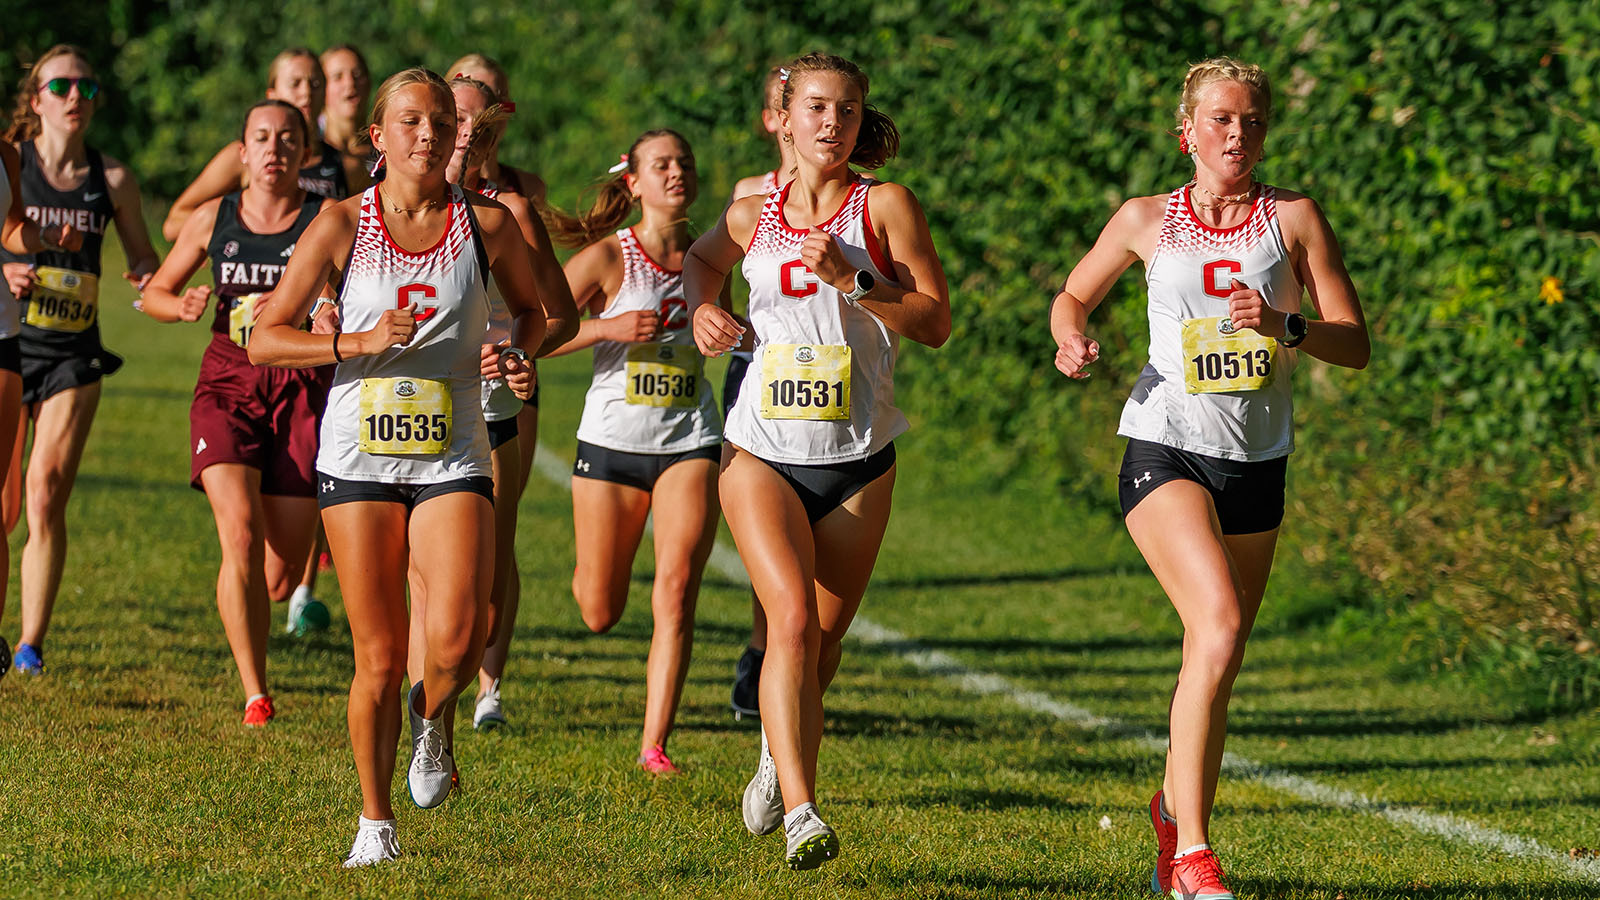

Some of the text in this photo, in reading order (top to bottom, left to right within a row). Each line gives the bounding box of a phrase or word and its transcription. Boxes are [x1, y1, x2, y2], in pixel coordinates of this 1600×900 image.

[25, 205, 106, 235] RINNELL
[220, 261, 288, 286] FAIT
[778, 257, 820, 299] C
[1201, 257, 1244, 300] C
[37, 296, 94, 323] 10634
[395, 281, 439, 324] C
[660, 296, 689, 330] C
[1191, 348, 1272, 381] 10513
[631, 373, 697, 398] 10538
[768, 379, 844, 408] 10531
[365, 413, 448, 442] 10535
